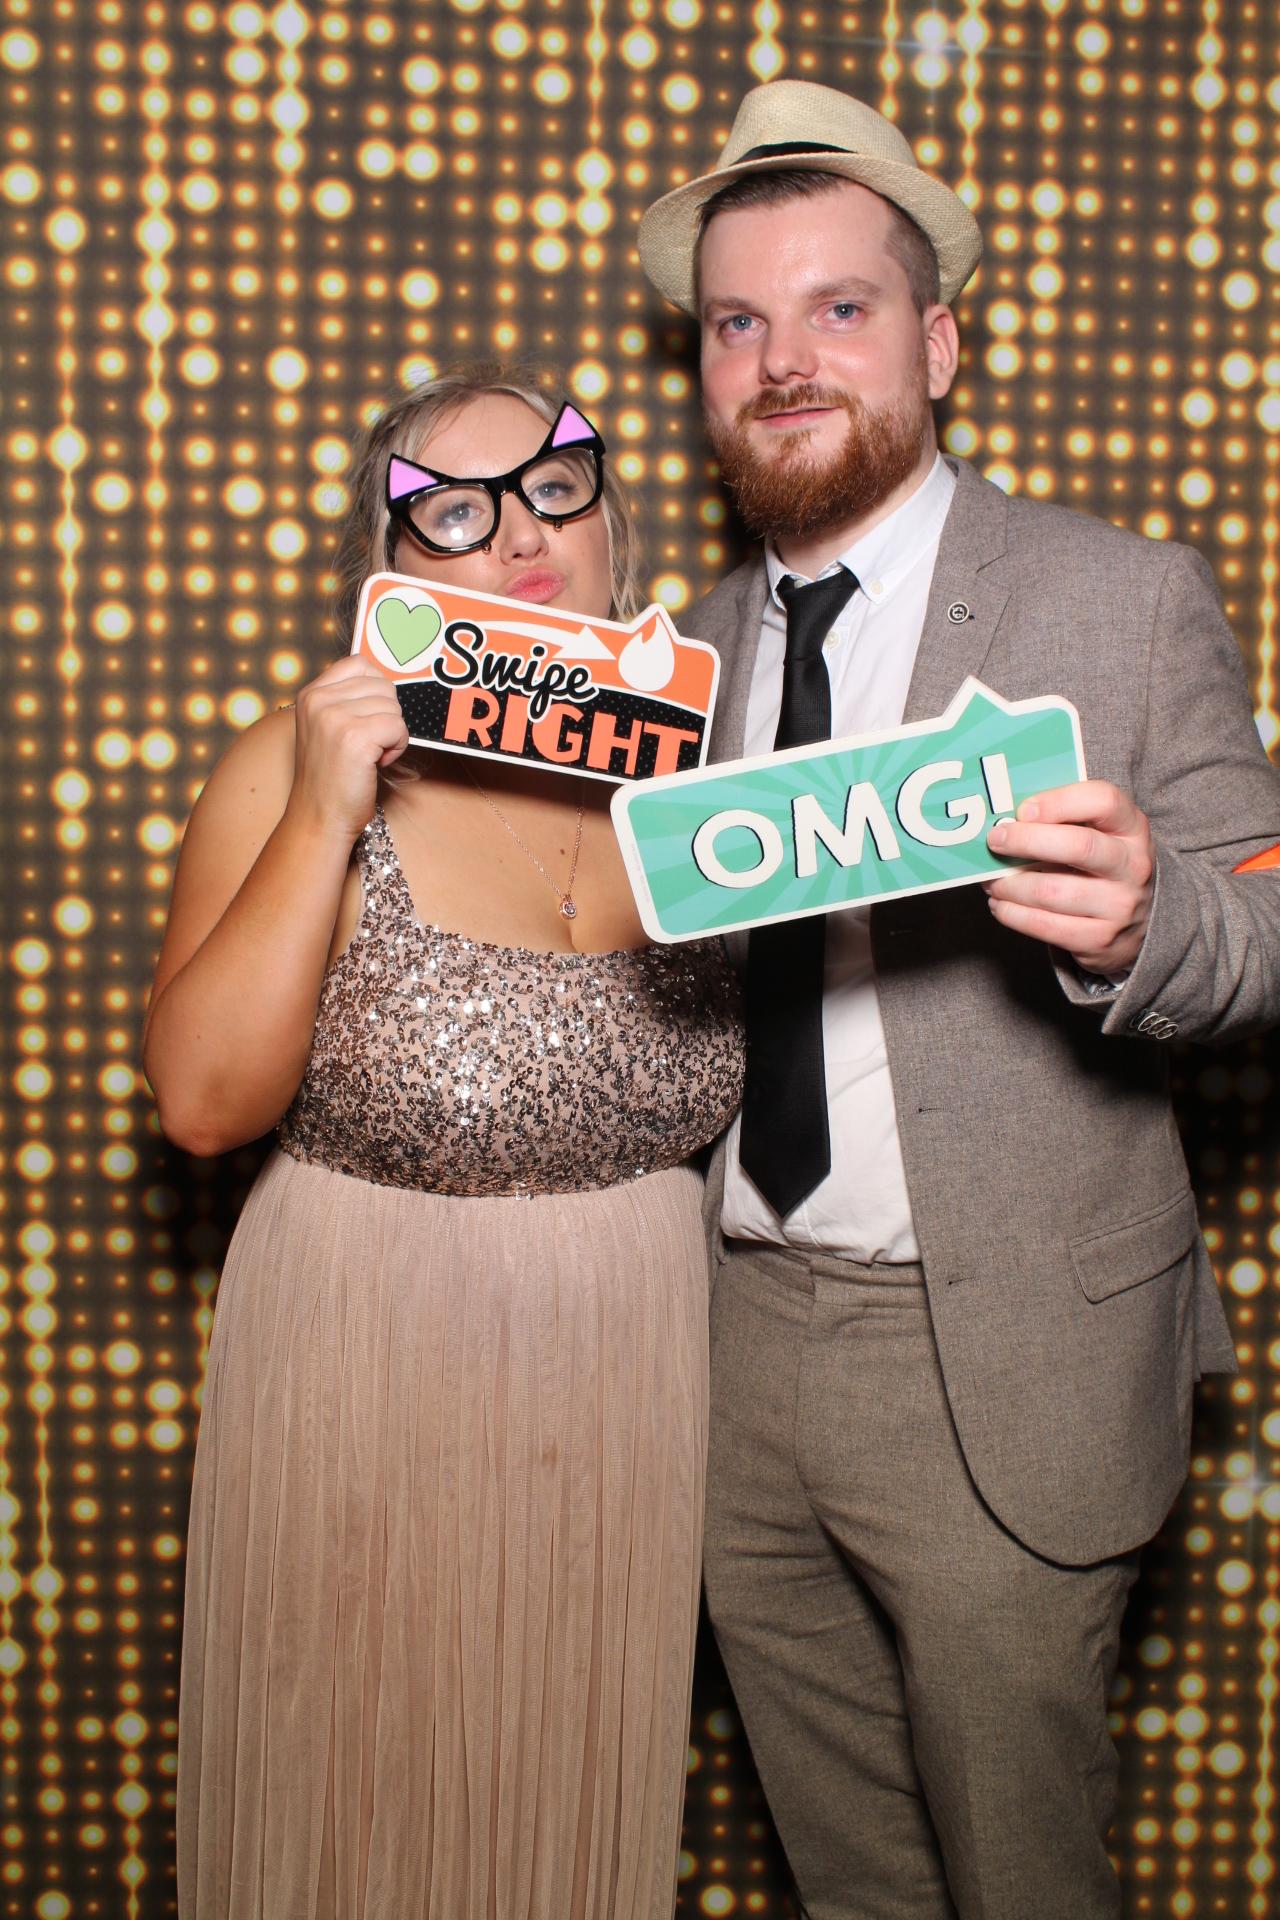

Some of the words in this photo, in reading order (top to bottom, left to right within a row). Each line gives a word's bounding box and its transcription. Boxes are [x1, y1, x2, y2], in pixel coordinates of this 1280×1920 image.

[434, 622, 596, 719] Swipe
[444, 687, 699, 777] RIGHT
[691, 752, 1017, 889] OMG!
